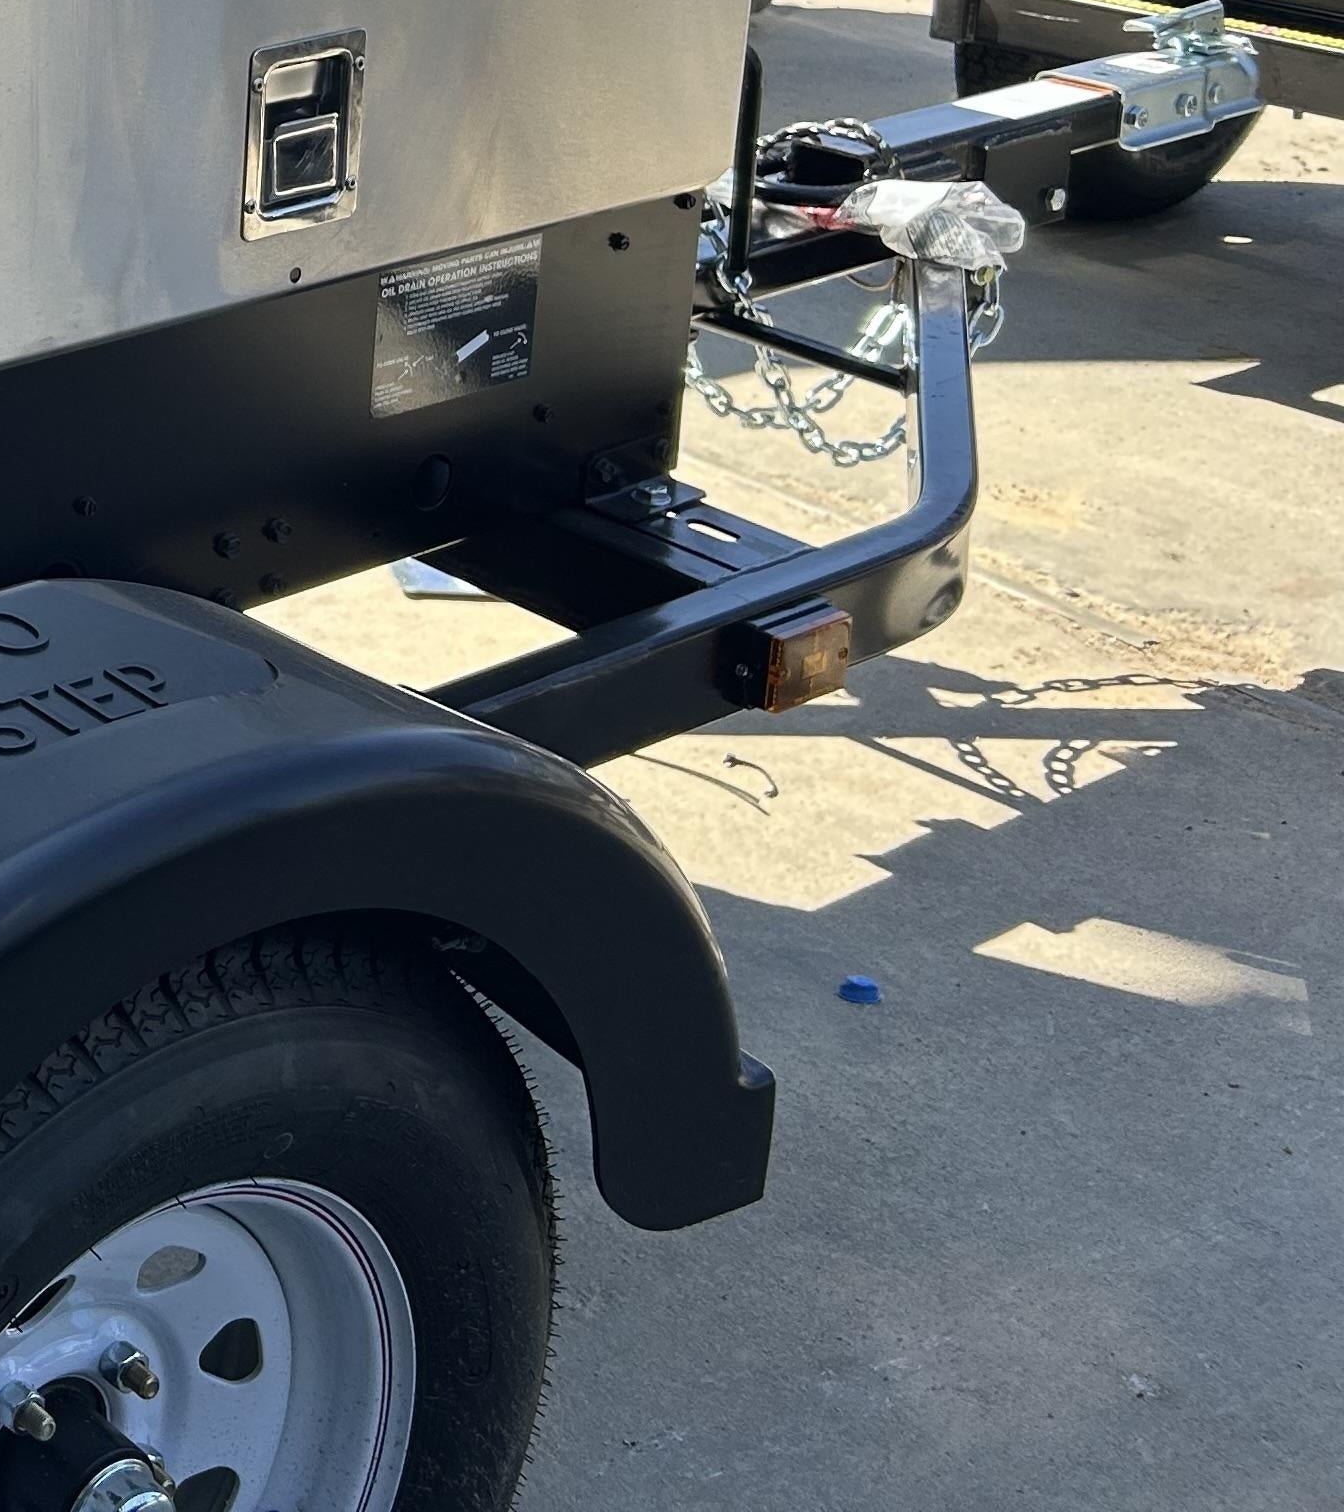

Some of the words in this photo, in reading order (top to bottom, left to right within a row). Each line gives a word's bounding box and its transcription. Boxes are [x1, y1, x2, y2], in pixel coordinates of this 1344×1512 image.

[381, 286, 395, 298] OIL
[397, 278, 426, 294] DRAIN
[427, 265, 476, 286] OPERATION
[478, 250, 537, 273] INSTRUCTIONS
